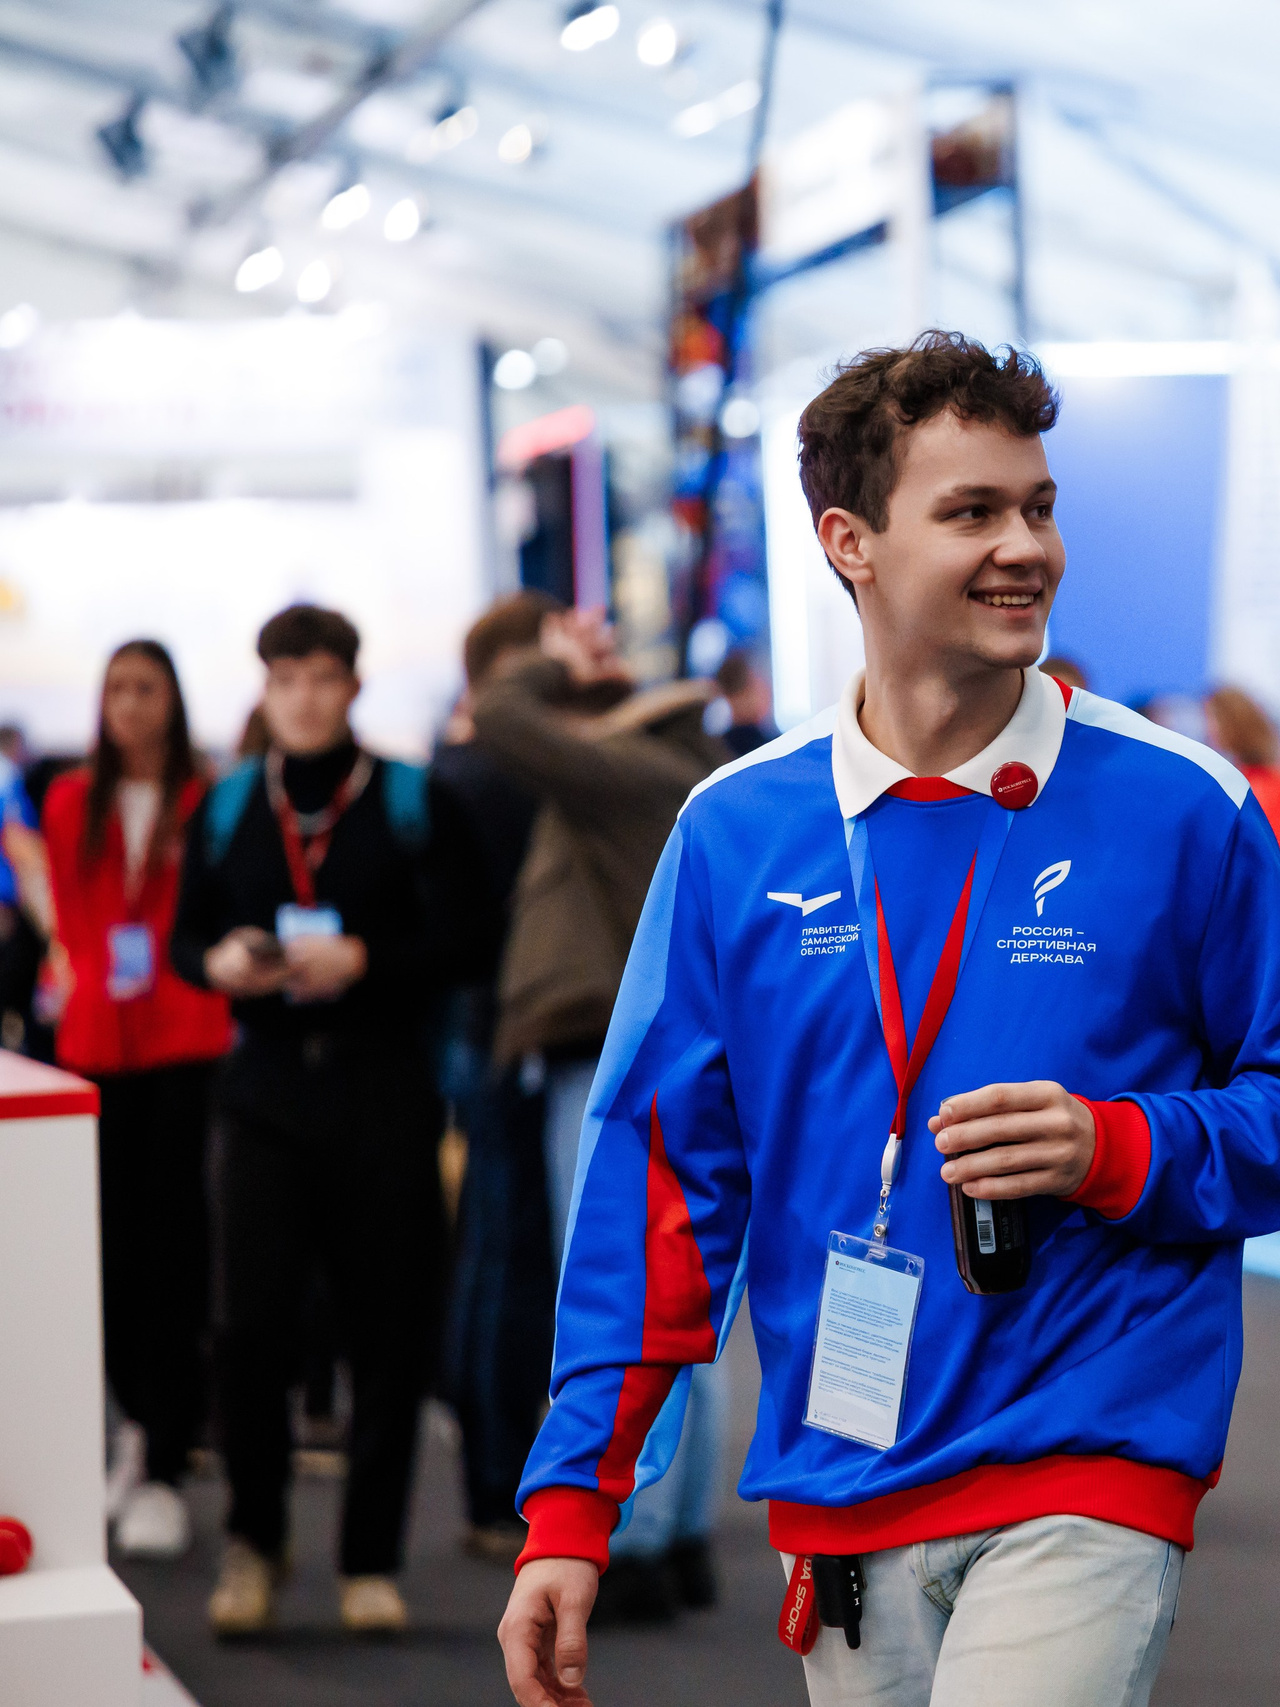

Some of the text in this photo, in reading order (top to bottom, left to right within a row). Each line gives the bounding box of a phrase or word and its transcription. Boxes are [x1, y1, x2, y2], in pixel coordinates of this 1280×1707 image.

[801, 923, 862, 937] ПРАВИТЕЛЬС
[1012, 926, 1073, 937] РОССИЯ
[801, 932, 859, 947] САМАРСКОЙ
[996, 939, 1097, 953] СПОРТИВНАЯ
[800, 944, 846, 957] ОБЛАСТИ
[1010, 953, 1085, 965] ДЕРЖАВА
[785, 1584, 807, 1645] SPORT
